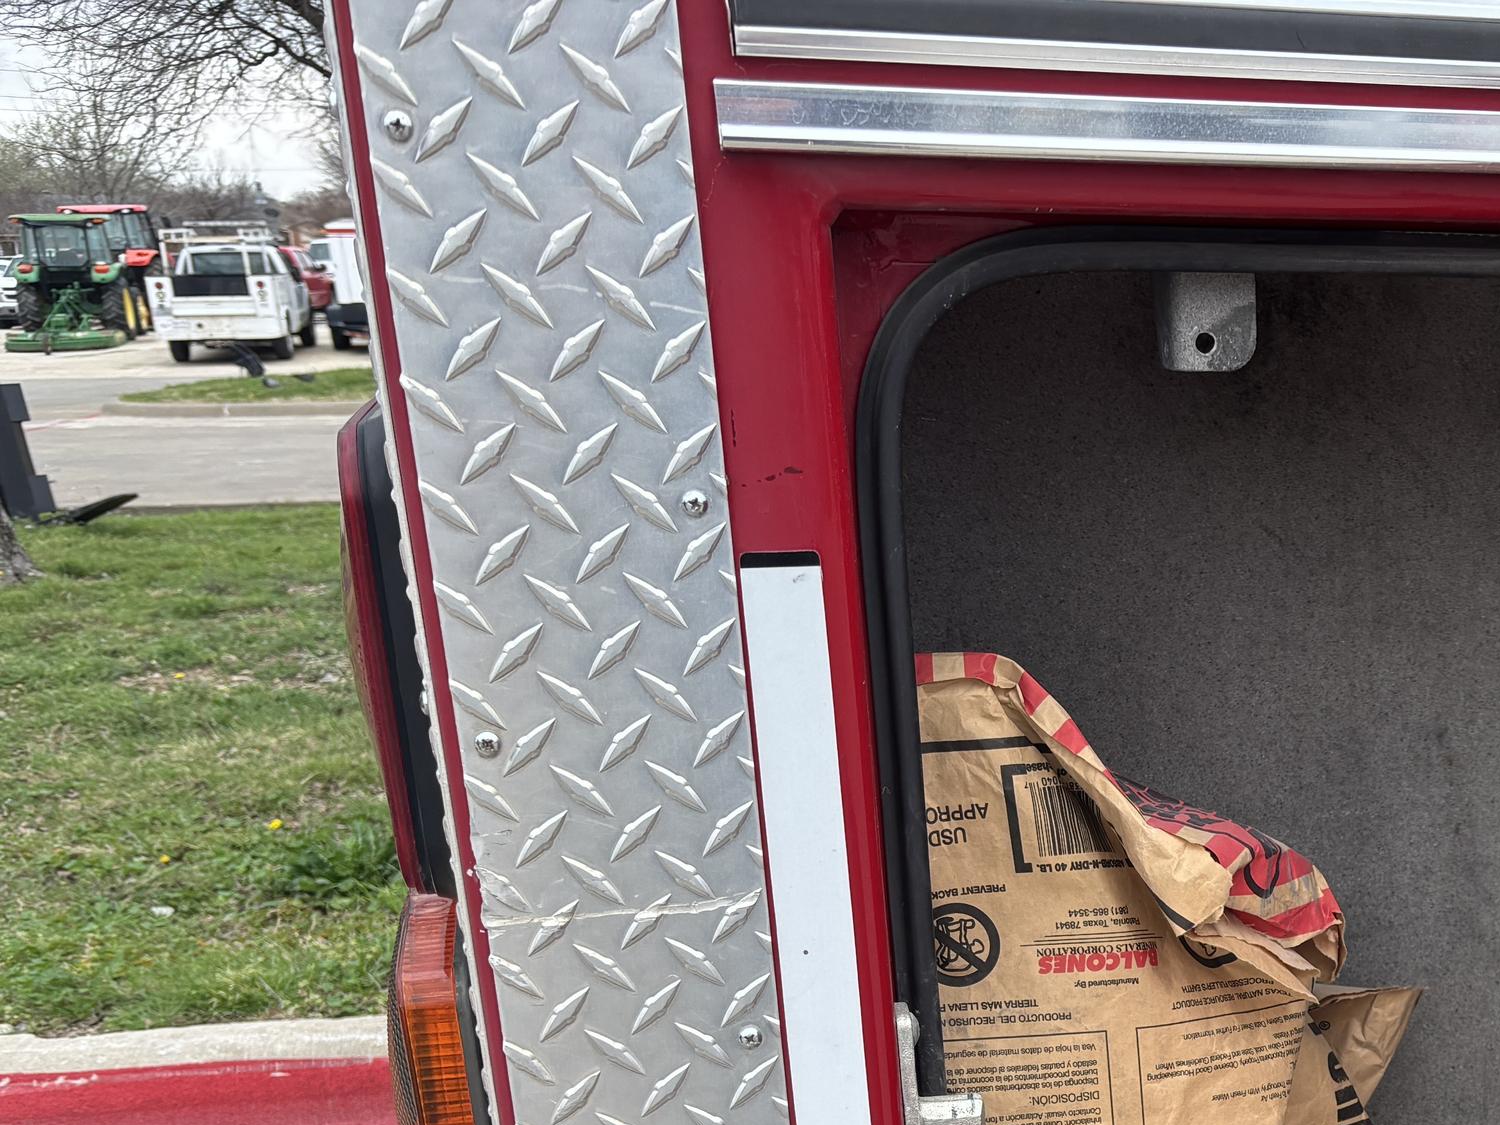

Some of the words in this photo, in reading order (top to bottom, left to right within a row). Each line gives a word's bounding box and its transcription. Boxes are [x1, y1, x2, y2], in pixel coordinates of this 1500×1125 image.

[1037, 863, 1052, 872] LB.
[1055, 862, 1067, 872] 40
[931, 888, 957, 899] BACK
[961, 884, 1005, 895] PREVENT
[1069, 907, 1108, 917] 865-3544
[1111, 906, 1128, 915] (361)
[1056, 920, 1081, 930] 78941
[1083, 919, 1107, 929] Texas
[1037, 945, 1113, 957] CORPORATION
[1116, 942, 1157, 953] MINERALS
[1039, 949, 1158, 974] BALCONES
[1075, 980, 1086, 988] By:
[1088, 978, 1139, 988] Manufactured
[1227, 978, 1274, 988] PROCESSED
[1181, 985, 1200, 993] EARTH
[1234, 989, 1263, 1002] NATURAL
[948, 1003, 979, 1011] LLENA
[981, 1001, 1002, 1011] MÁS
[1004, 999, 1038, 1009] TIERRA
[1172, 998, 1203, 1010] PRODUCT
[948, 1016, 995, 1026] RECURSO
[998, 1016, 1016, 1024] DEL
[1019, 1012, 1072, 1023] PRODUCTO
[1147, 1068, 1194, 1081] Housekeeping
[1195, 1067, 1212, 1075] Good
[1029, 1090, 1099, 1106] DISPOSICIÓN:
